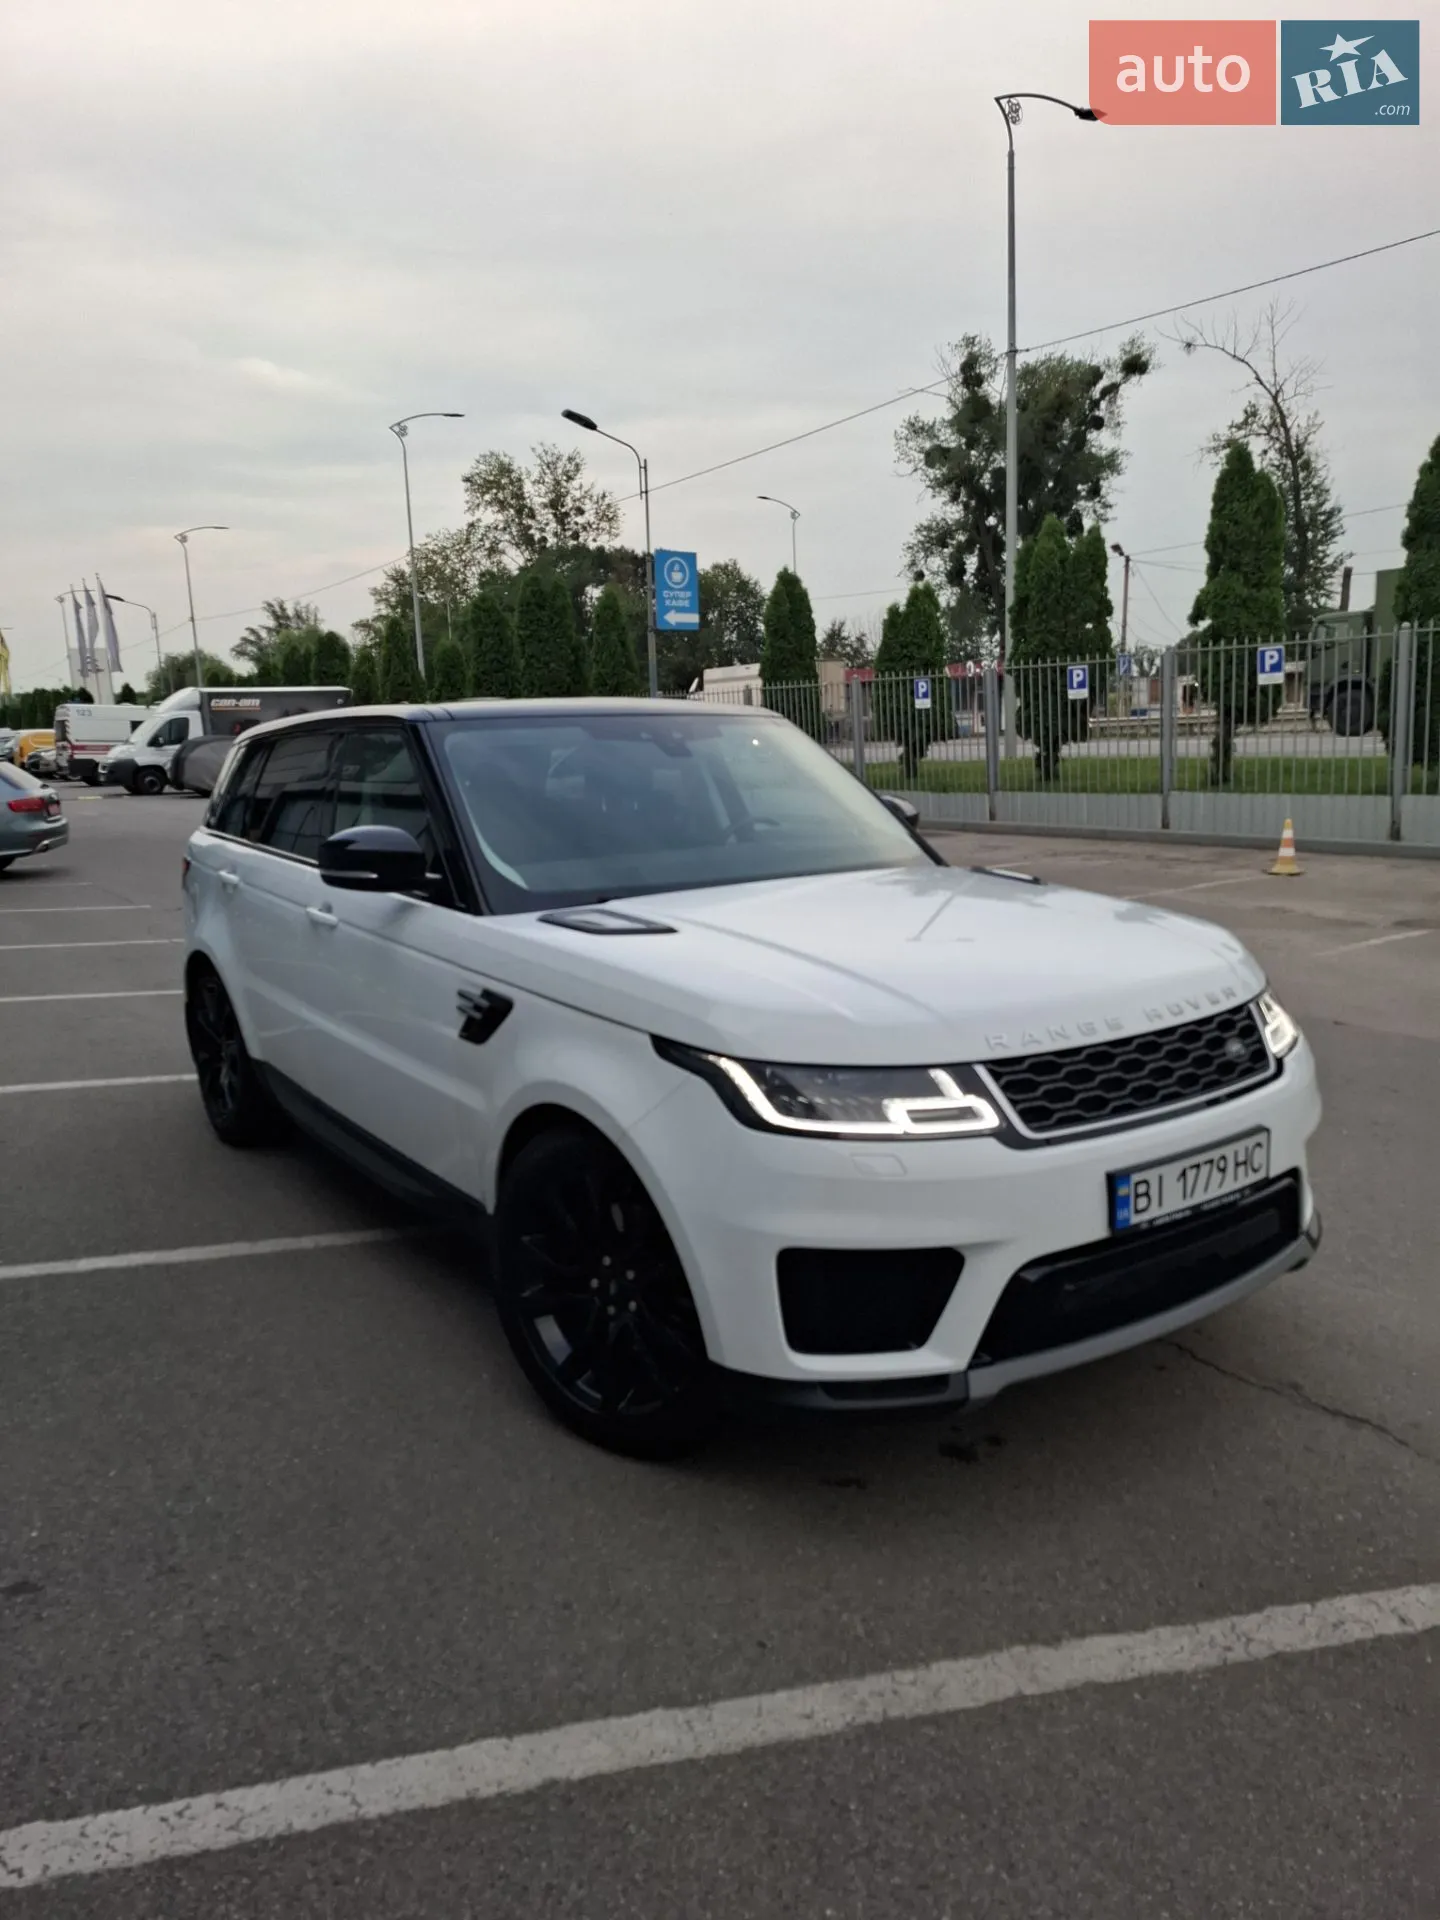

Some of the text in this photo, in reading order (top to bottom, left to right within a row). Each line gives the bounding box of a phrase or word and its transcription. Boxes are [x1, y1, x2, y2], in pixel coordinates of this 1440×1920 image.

[1264, 650, 1280, 673] P
[918, 681, 928, 698] P
[1072, 670, 1084, 689] P
[985, 986, 1238, 1052] RANGE ROVER
[1134, 1173, 1163, 1215] BI
[1176, 1153, 1228, 1201] 1779
[1233, 1142, 1264, 1183] HC
